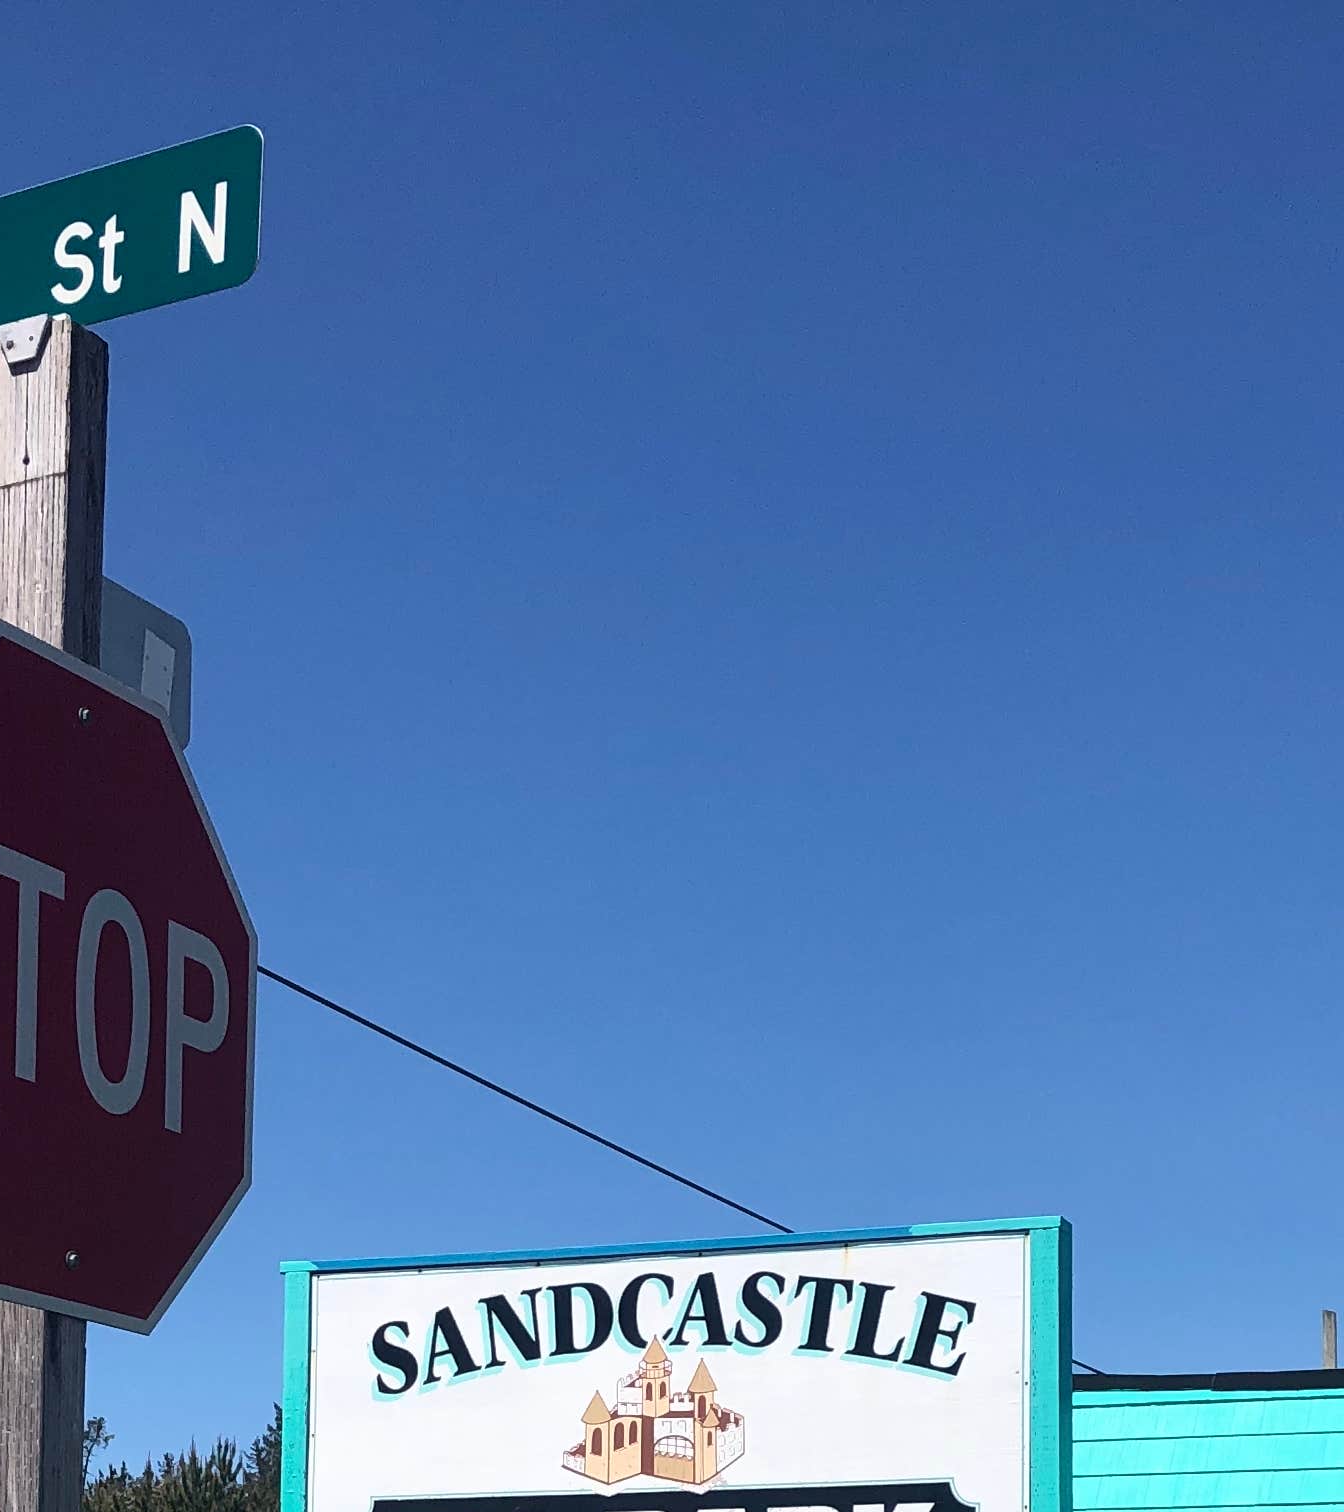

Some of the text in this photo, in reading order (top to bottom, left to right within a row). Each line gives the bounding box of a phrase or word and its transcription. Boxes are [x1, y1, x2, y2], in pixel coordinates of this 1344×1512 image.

[50, 214, 125, 305] St
[177, 180, 228, 274] N
[369, 1270, 977, 1400] SANDCASTLE
